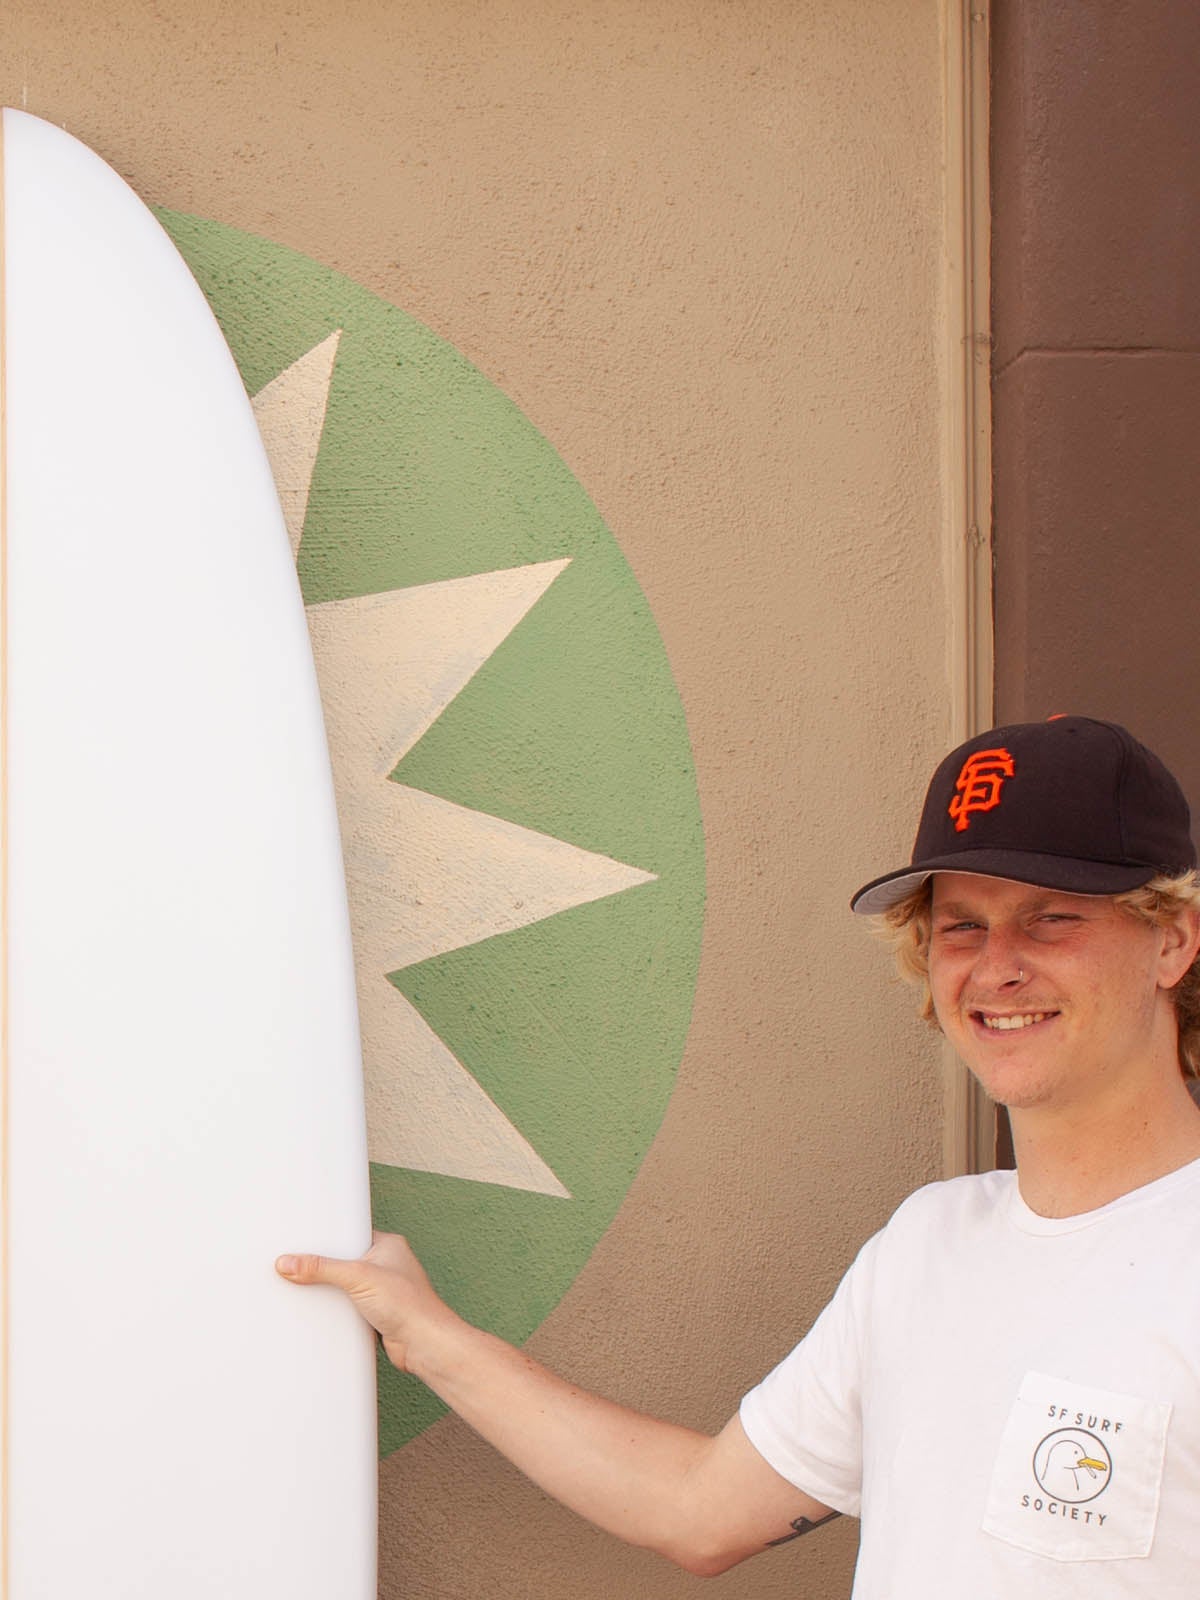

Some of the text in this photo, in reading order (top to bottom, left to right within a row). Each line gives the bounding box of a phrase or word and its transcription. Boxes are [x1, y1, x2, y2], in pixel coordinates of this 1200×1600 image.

[948, 748, 1015, 832] SF
[1048, 1405, 1123, 1433] SF SURF
[1021, 1495, 1107, 1526] SOCIETY
